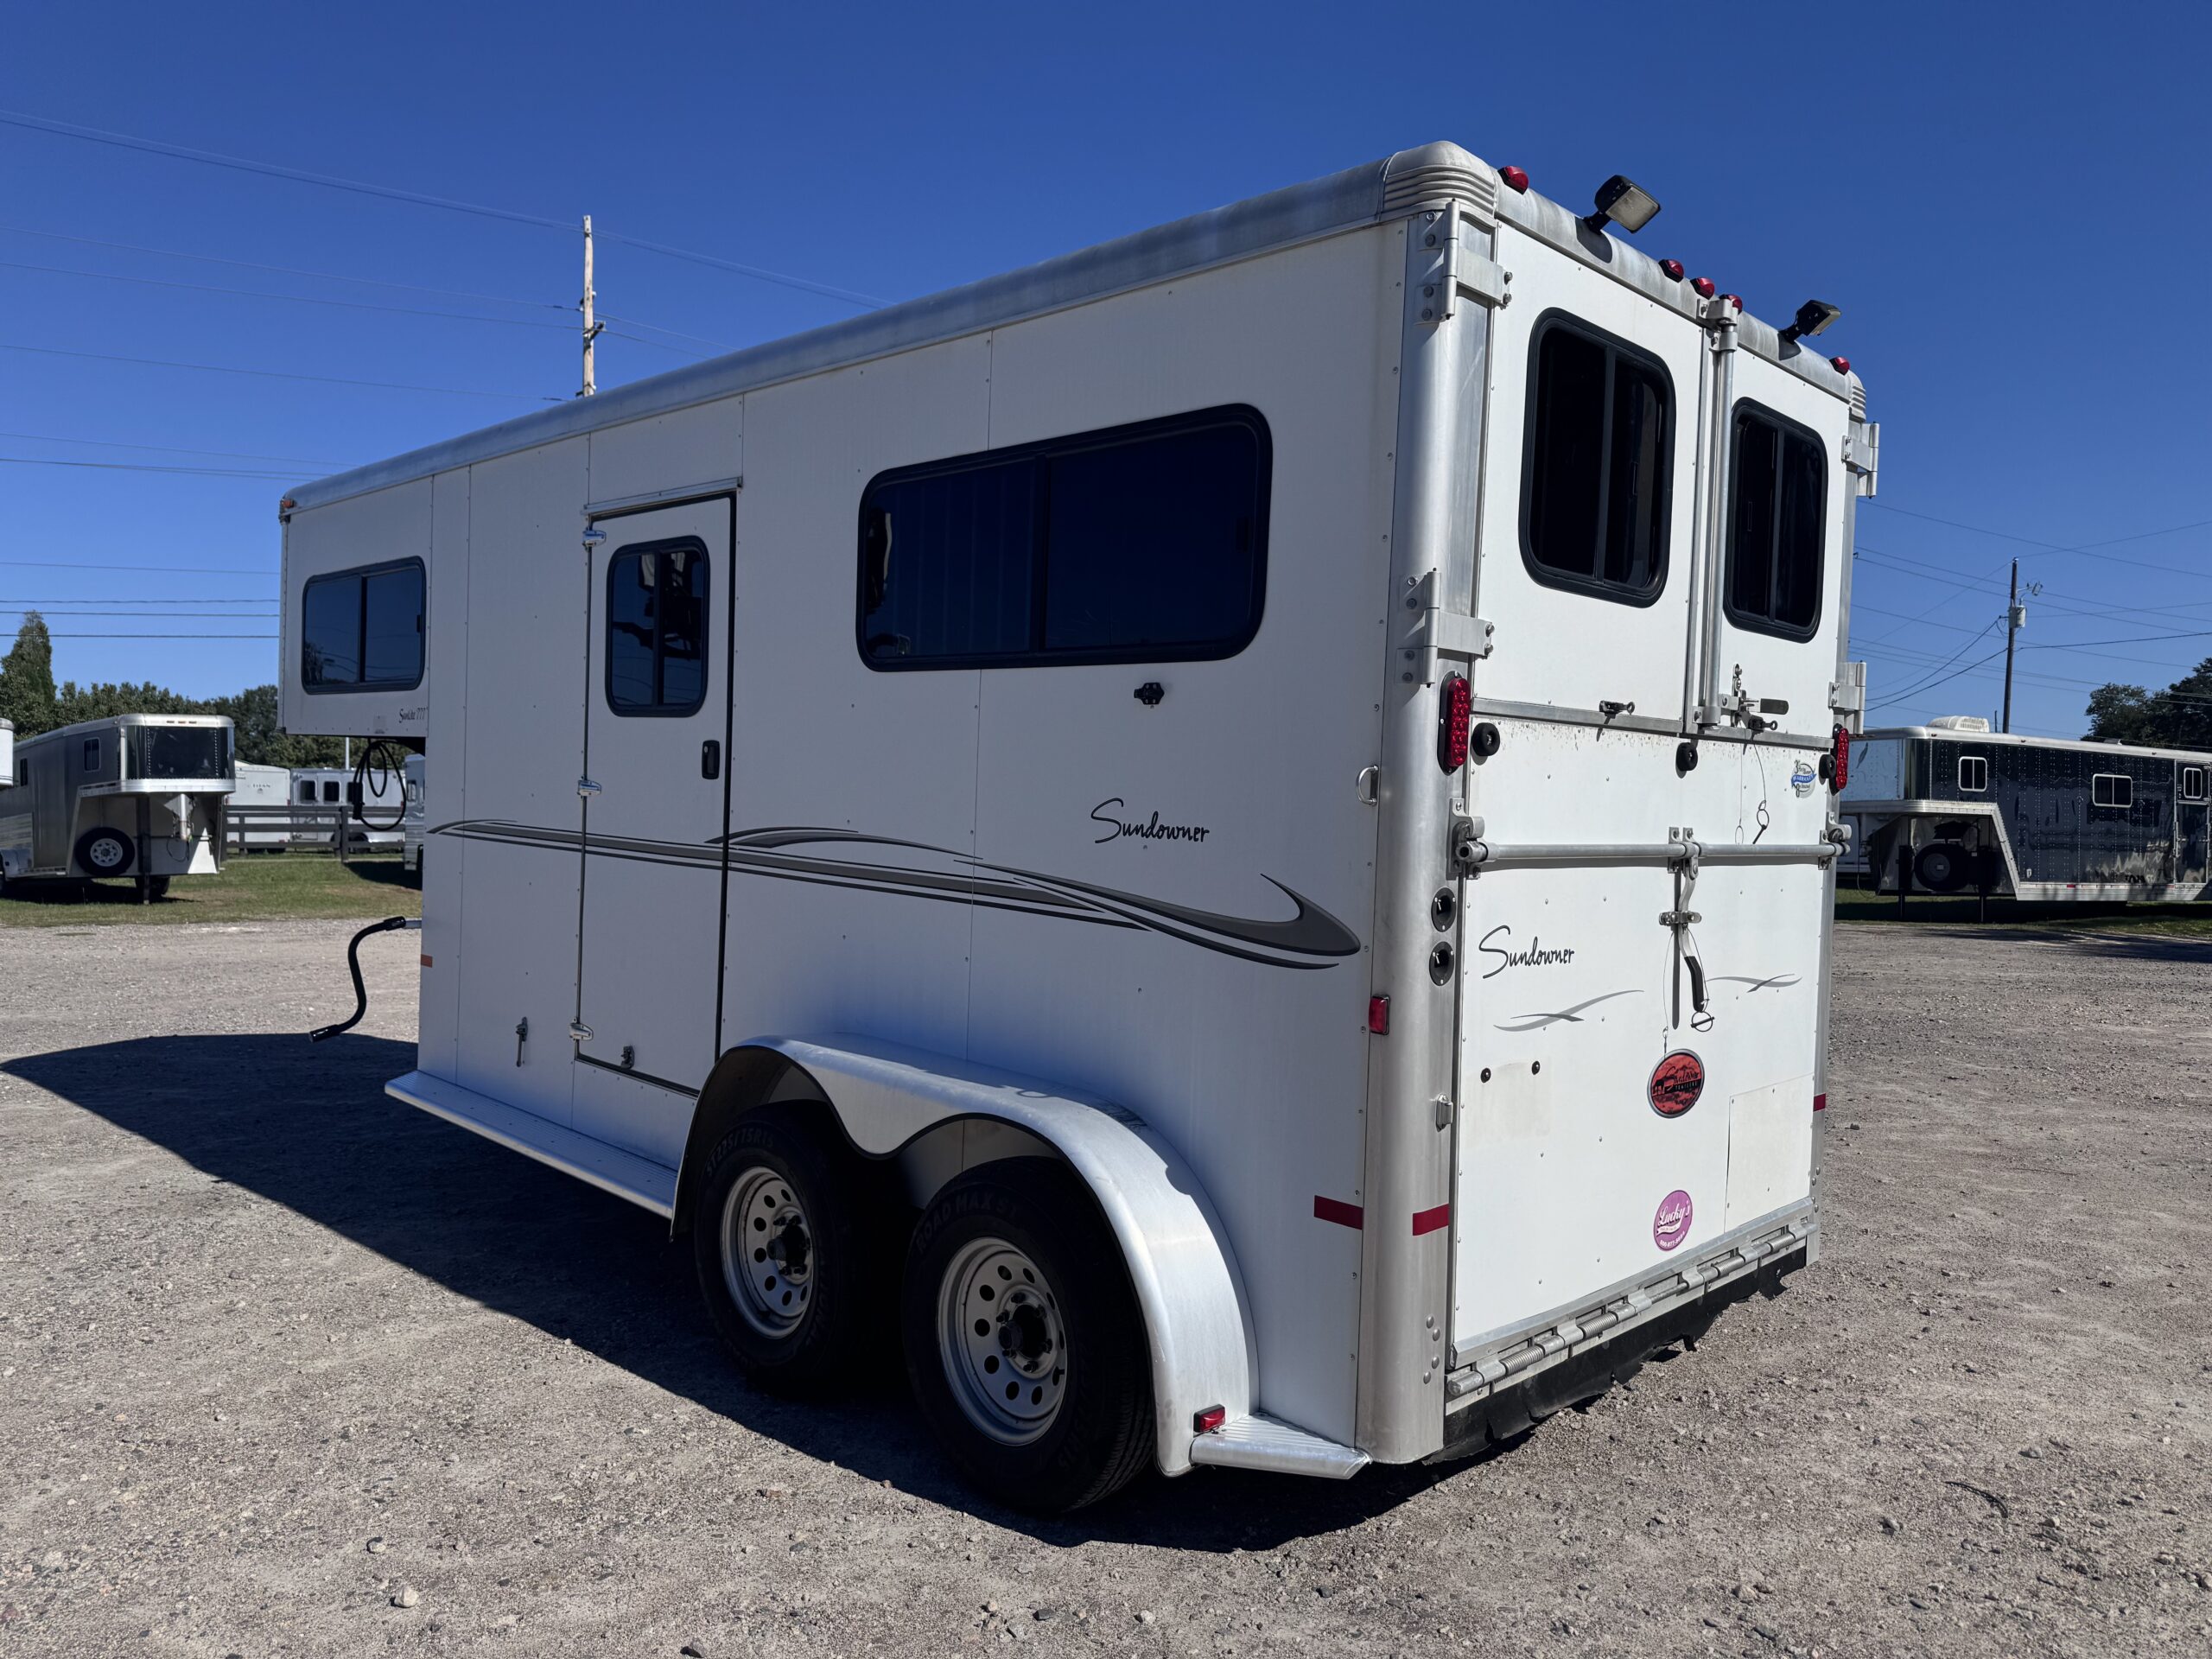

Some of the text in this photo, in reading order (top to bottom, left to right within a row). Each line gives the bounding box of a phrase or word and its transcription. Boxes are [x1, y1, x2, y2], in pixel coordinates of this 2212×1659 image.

[416, 707, 426, 720] 777
[1090, 797, 1210, 844] Sundowner
[1478, 925, 1574, 979] Sundowner
[955, 1190, 995, 1215] MAX
[1657, 1200, 1691, 1226] Lucky's
